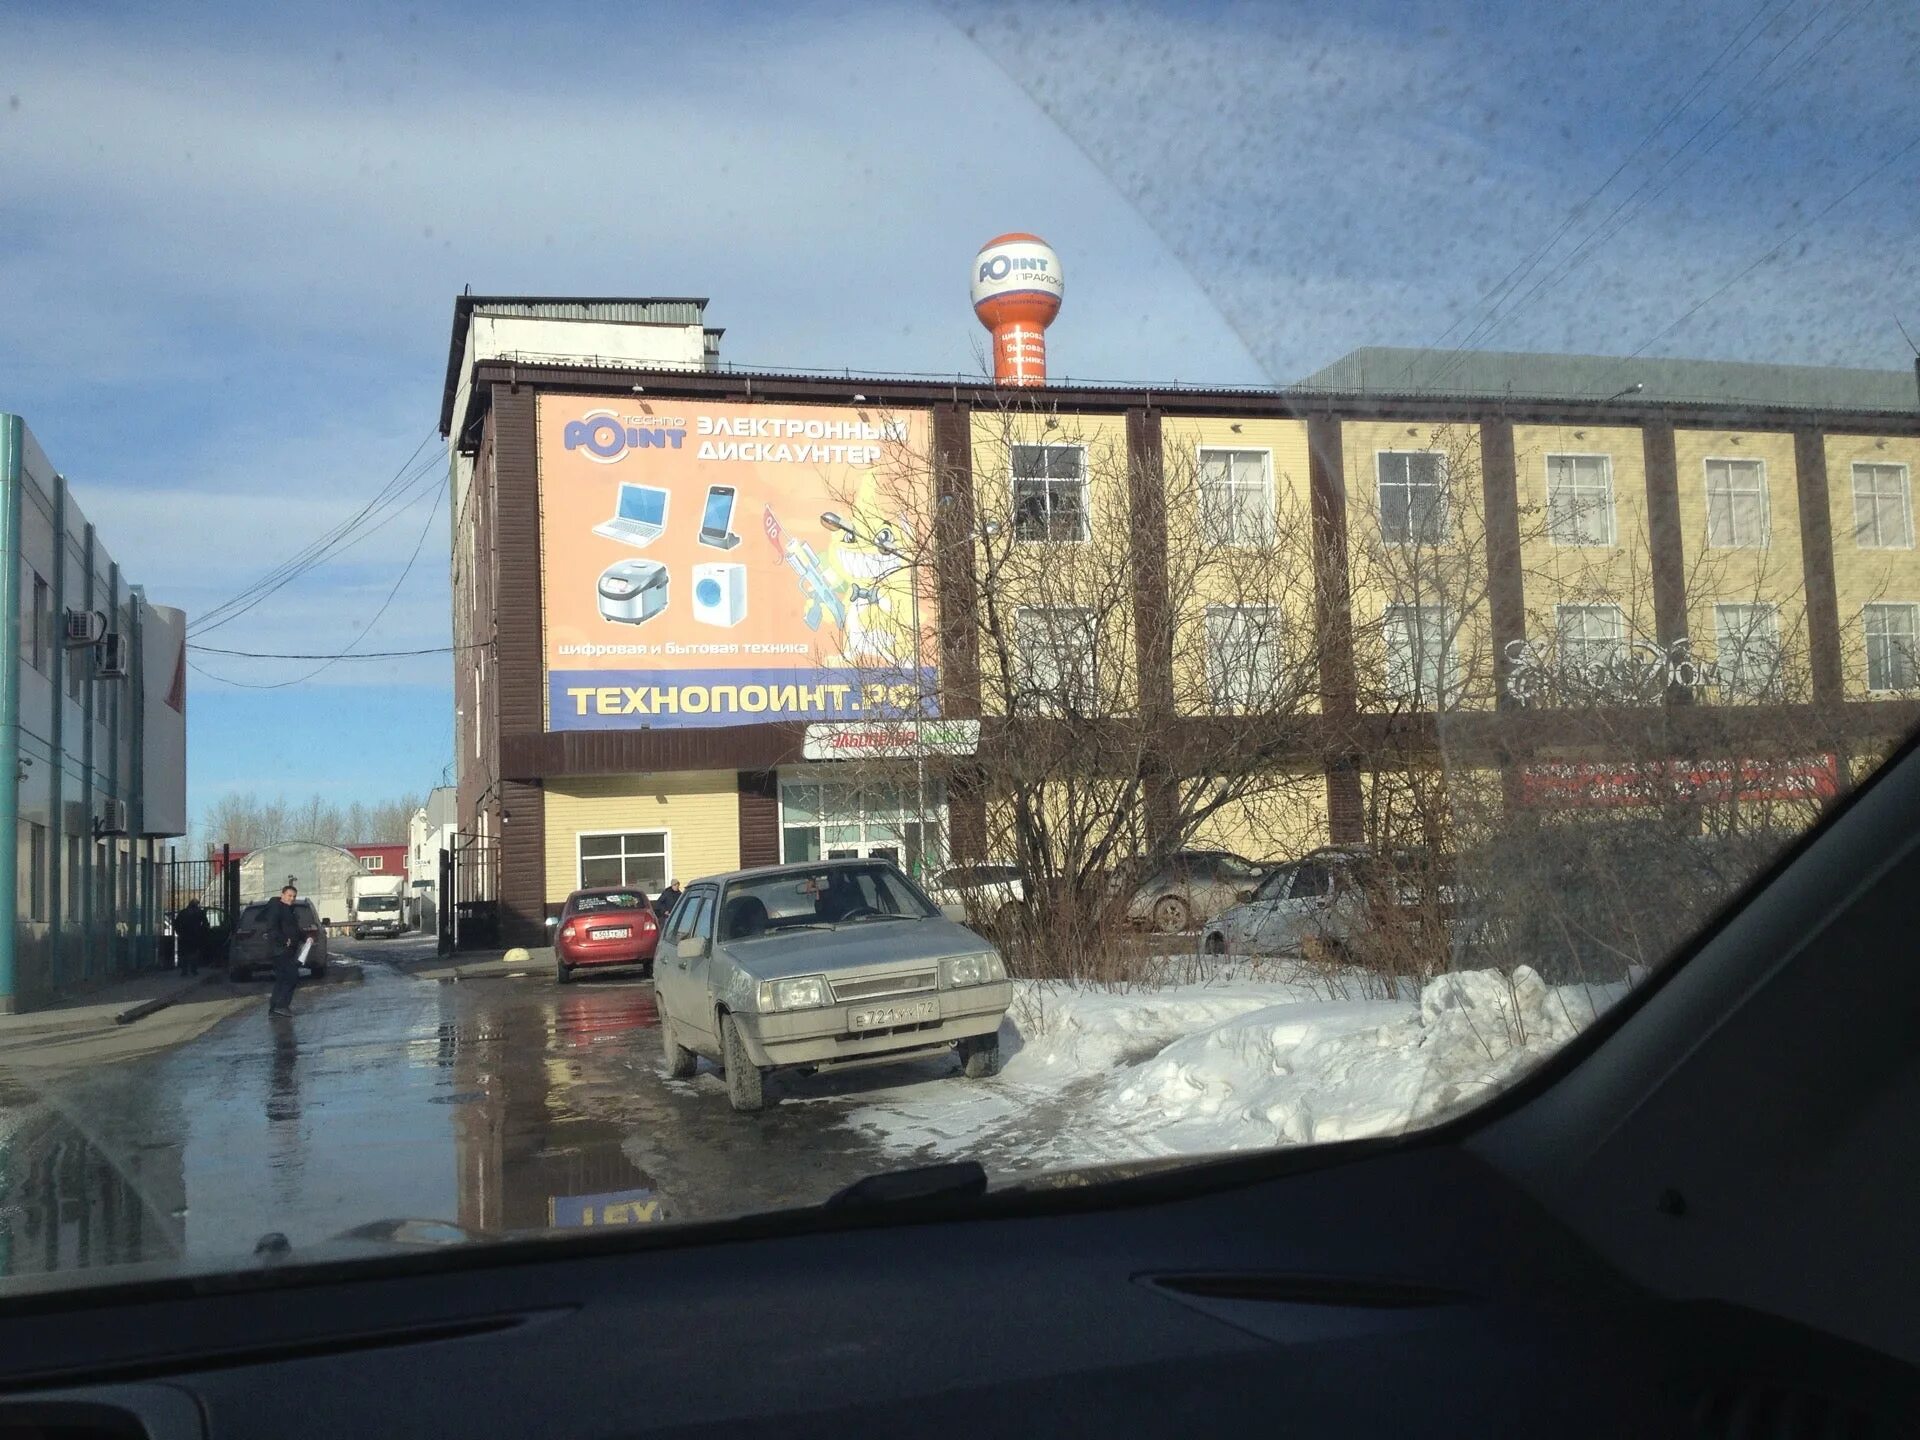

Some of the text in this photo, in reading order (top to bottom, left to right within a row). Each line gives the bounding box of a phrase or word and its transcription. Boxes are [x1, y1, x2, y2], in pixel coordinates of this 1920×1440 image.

[979, 254, 1048, 283] POINT
[623, 415, 687, 427] TECHNO
[696, 415, 907, 441] ЭЛЕКТРОННЫЙ
[564, 416, 687, 457] POINT
[696, 441, 881, 464] ДИСКАУНТЕР
[558, 642, 809, 656] цифровая и бытовая техника
[567, 684, 917, 715] ТЕХНОПОИНТ.РФ
